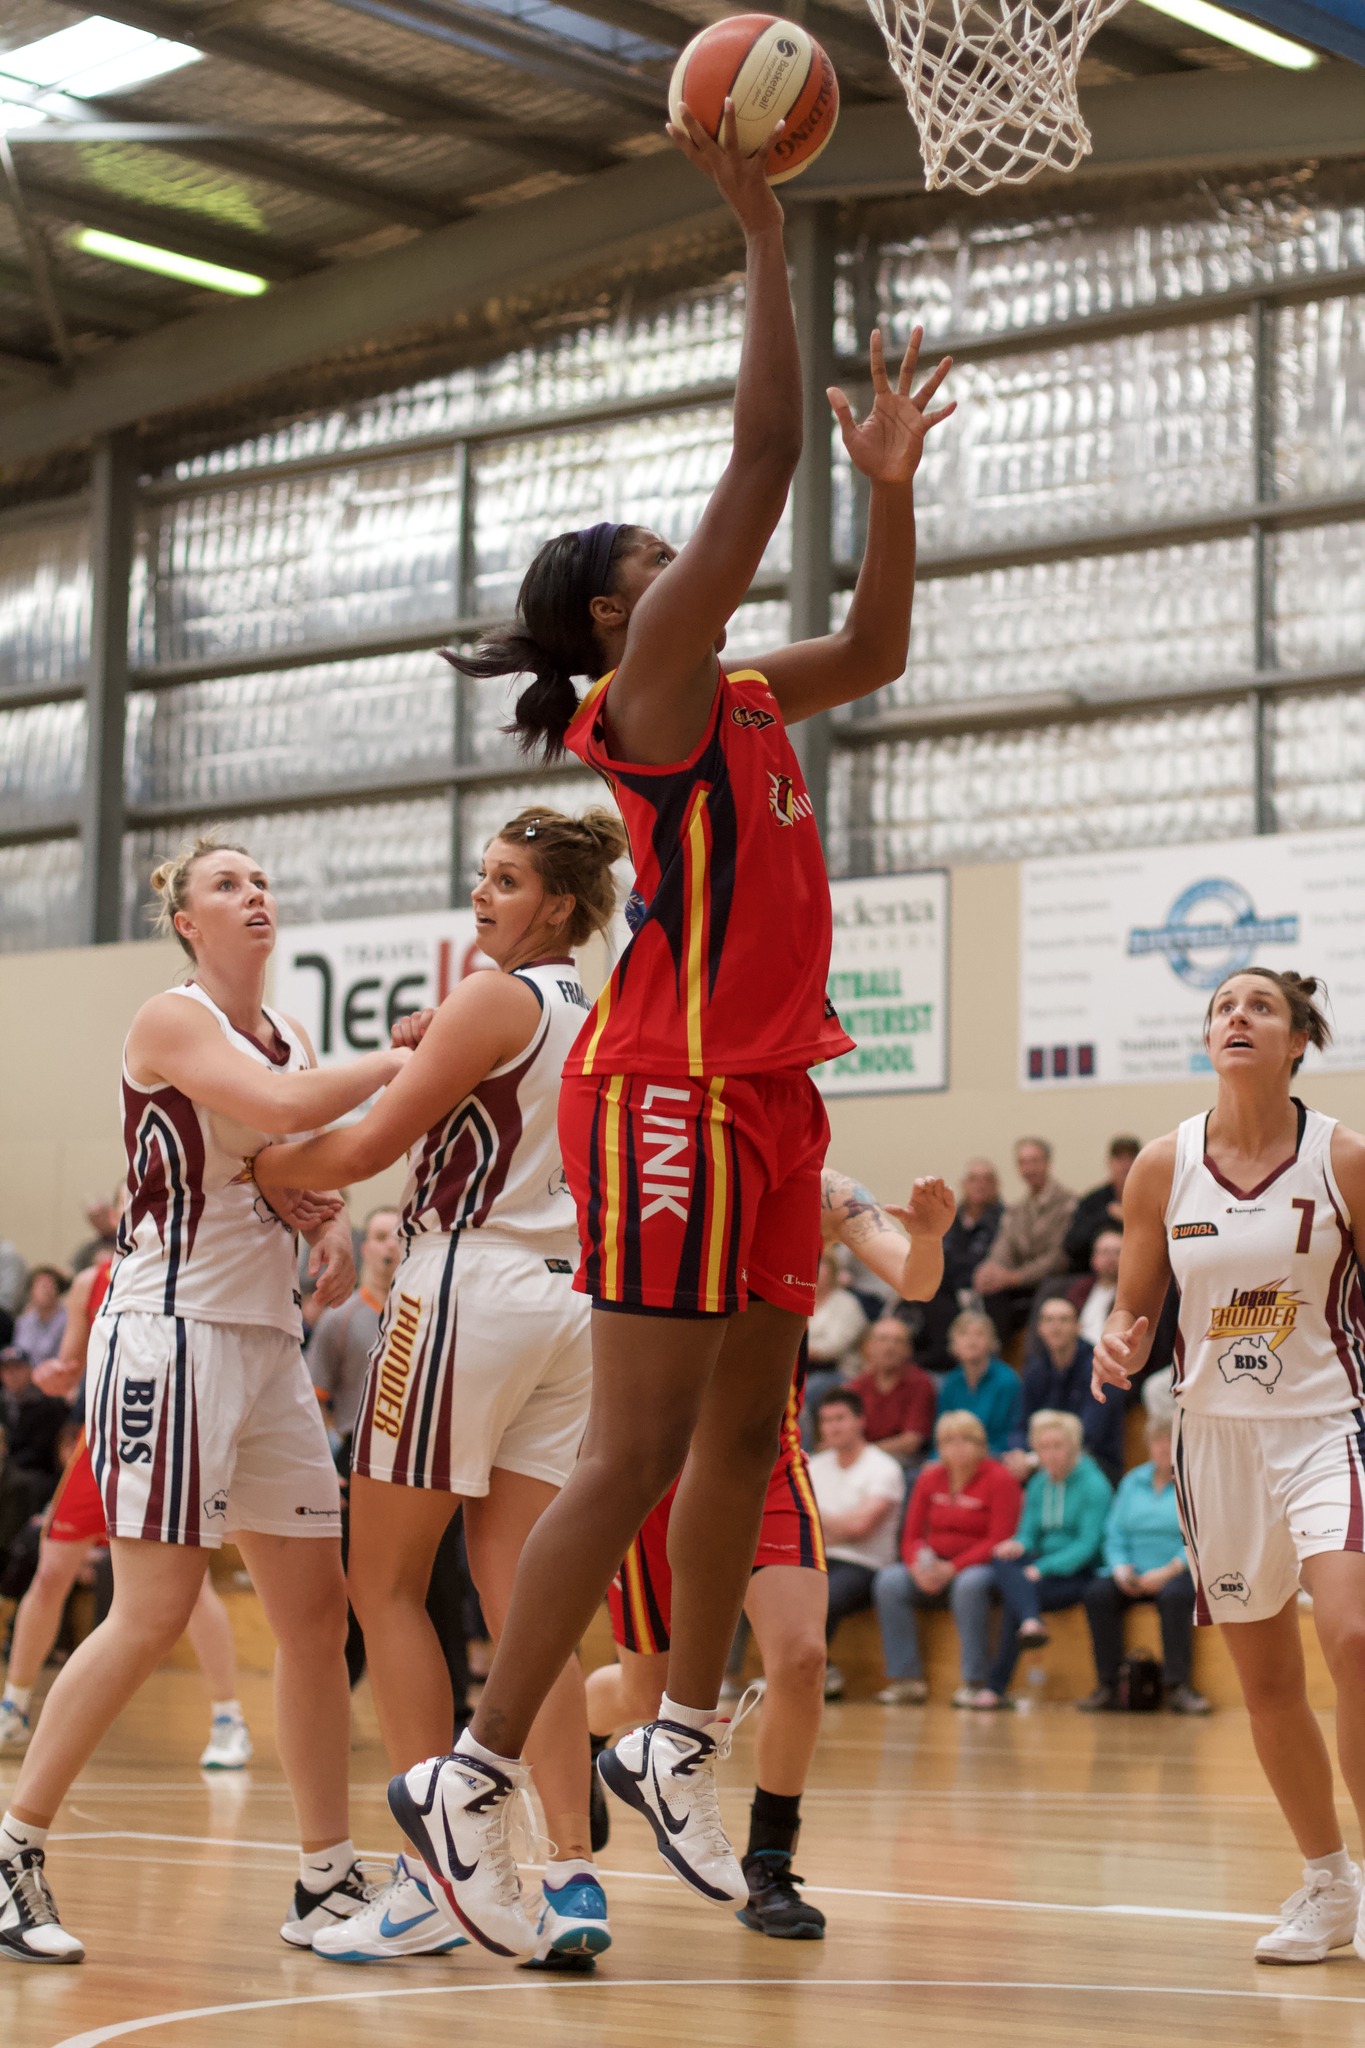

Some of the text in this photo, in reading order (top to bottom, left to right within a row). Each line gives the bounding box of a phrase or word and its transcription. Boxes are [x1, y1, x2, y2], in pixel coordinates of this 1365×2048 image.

[759, 60, 789, 110] Basketball
[641, 1084, 690, 1222] LINK
[1292, 1198, 1315, 1254] 7
[1211, 1306, 1298, 1327] THUNDER
[1230, 1288, 1278, 1308] Logan
[372, 1292, 422, 1440] THUNDER
[1234, 1354, 1268, 1370] BDS
[120, 1376, 156, 1465] BDS
[1220, 1582, 1244, 1593] BDS
